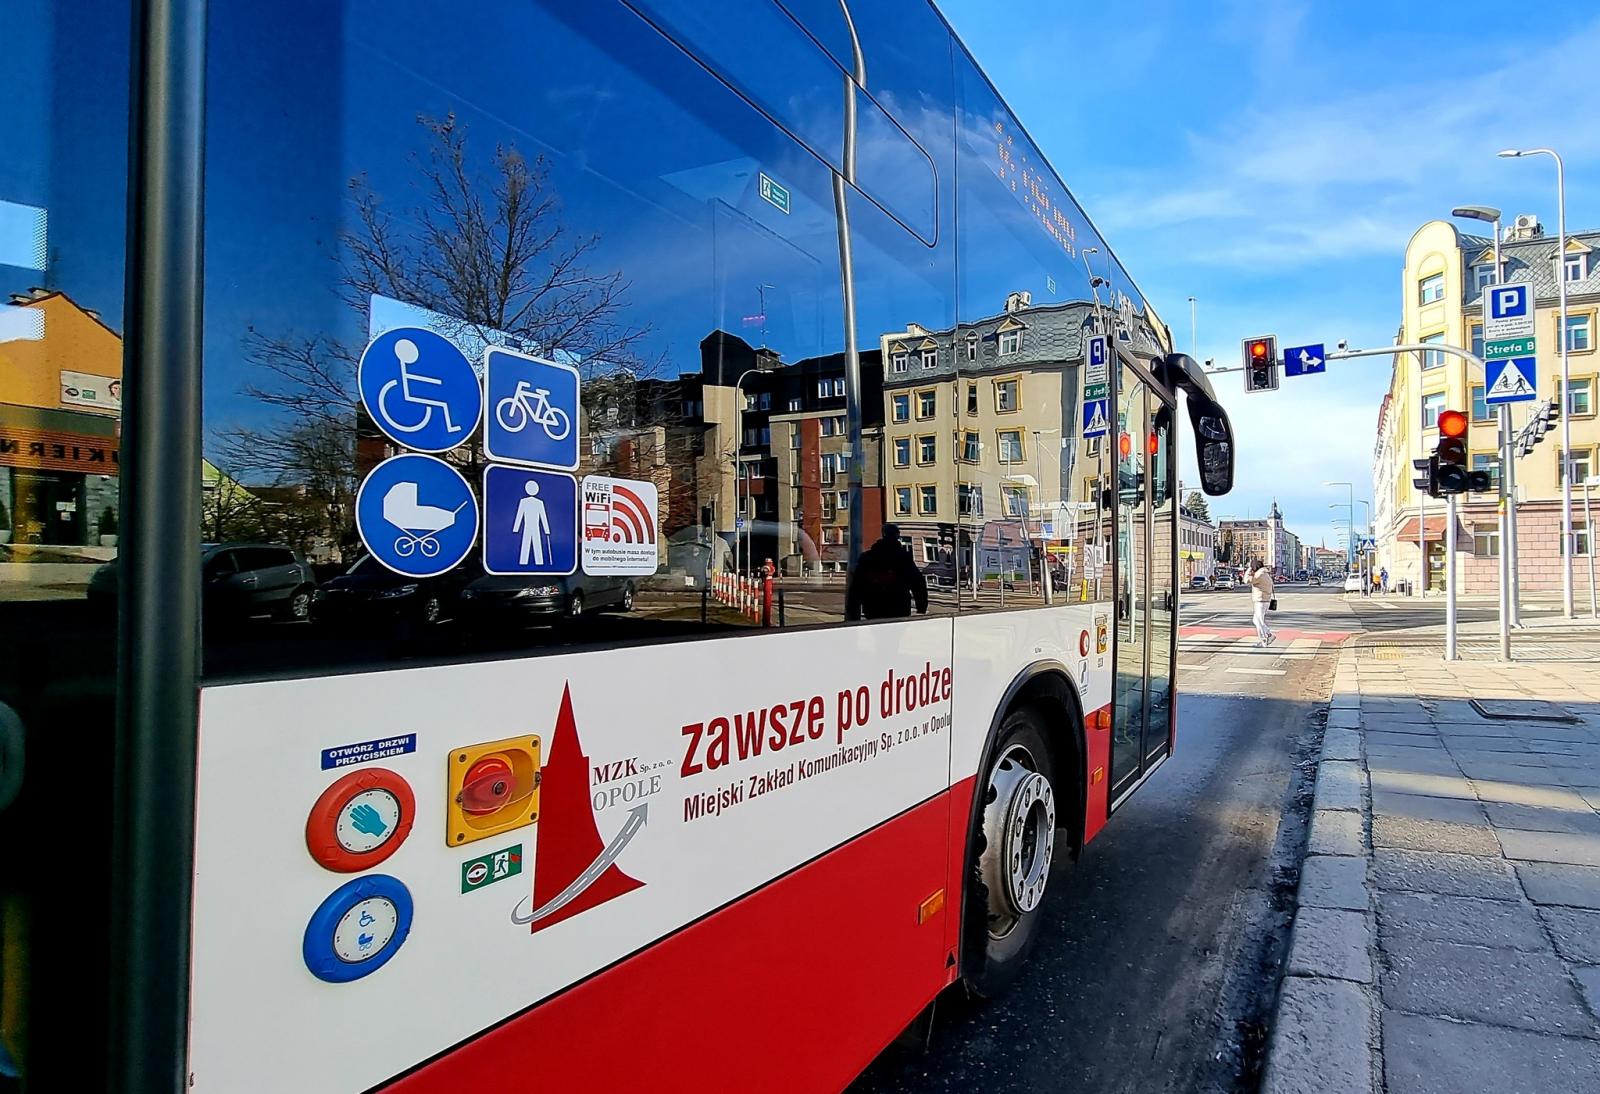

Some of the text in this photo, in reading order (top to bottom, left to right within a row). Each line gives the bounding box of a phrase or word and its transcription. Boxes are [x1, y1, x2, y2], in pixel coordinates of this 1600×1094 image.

[1499, 290, 1519, 315] P
[1487, 341, 1535, 355] Strefa B
[585, 491, 611, 504] WiFi
[586, 482, 610, 492] FREE
[680, 661, 951, 779] zawsze po drodze
[329, 737, 410, 758] OTWÓRZ DRZWI
[335, 746, 404, 766] PRZYCISKIEM
[592, 757, 638, 786] MZK
[684, 780, 744, 822] Miejski
[748, 763, 794, 799] Zakład
[798, 737, 879, 781] Komunikacyjny
[881, 732, 895, 753] Sp.
[898, 731, 903, 744] z
[922, 723, 929, 735] w
[930, 713, 951, 732] Opolu
[593, 774, 662, 812] OPOLE
